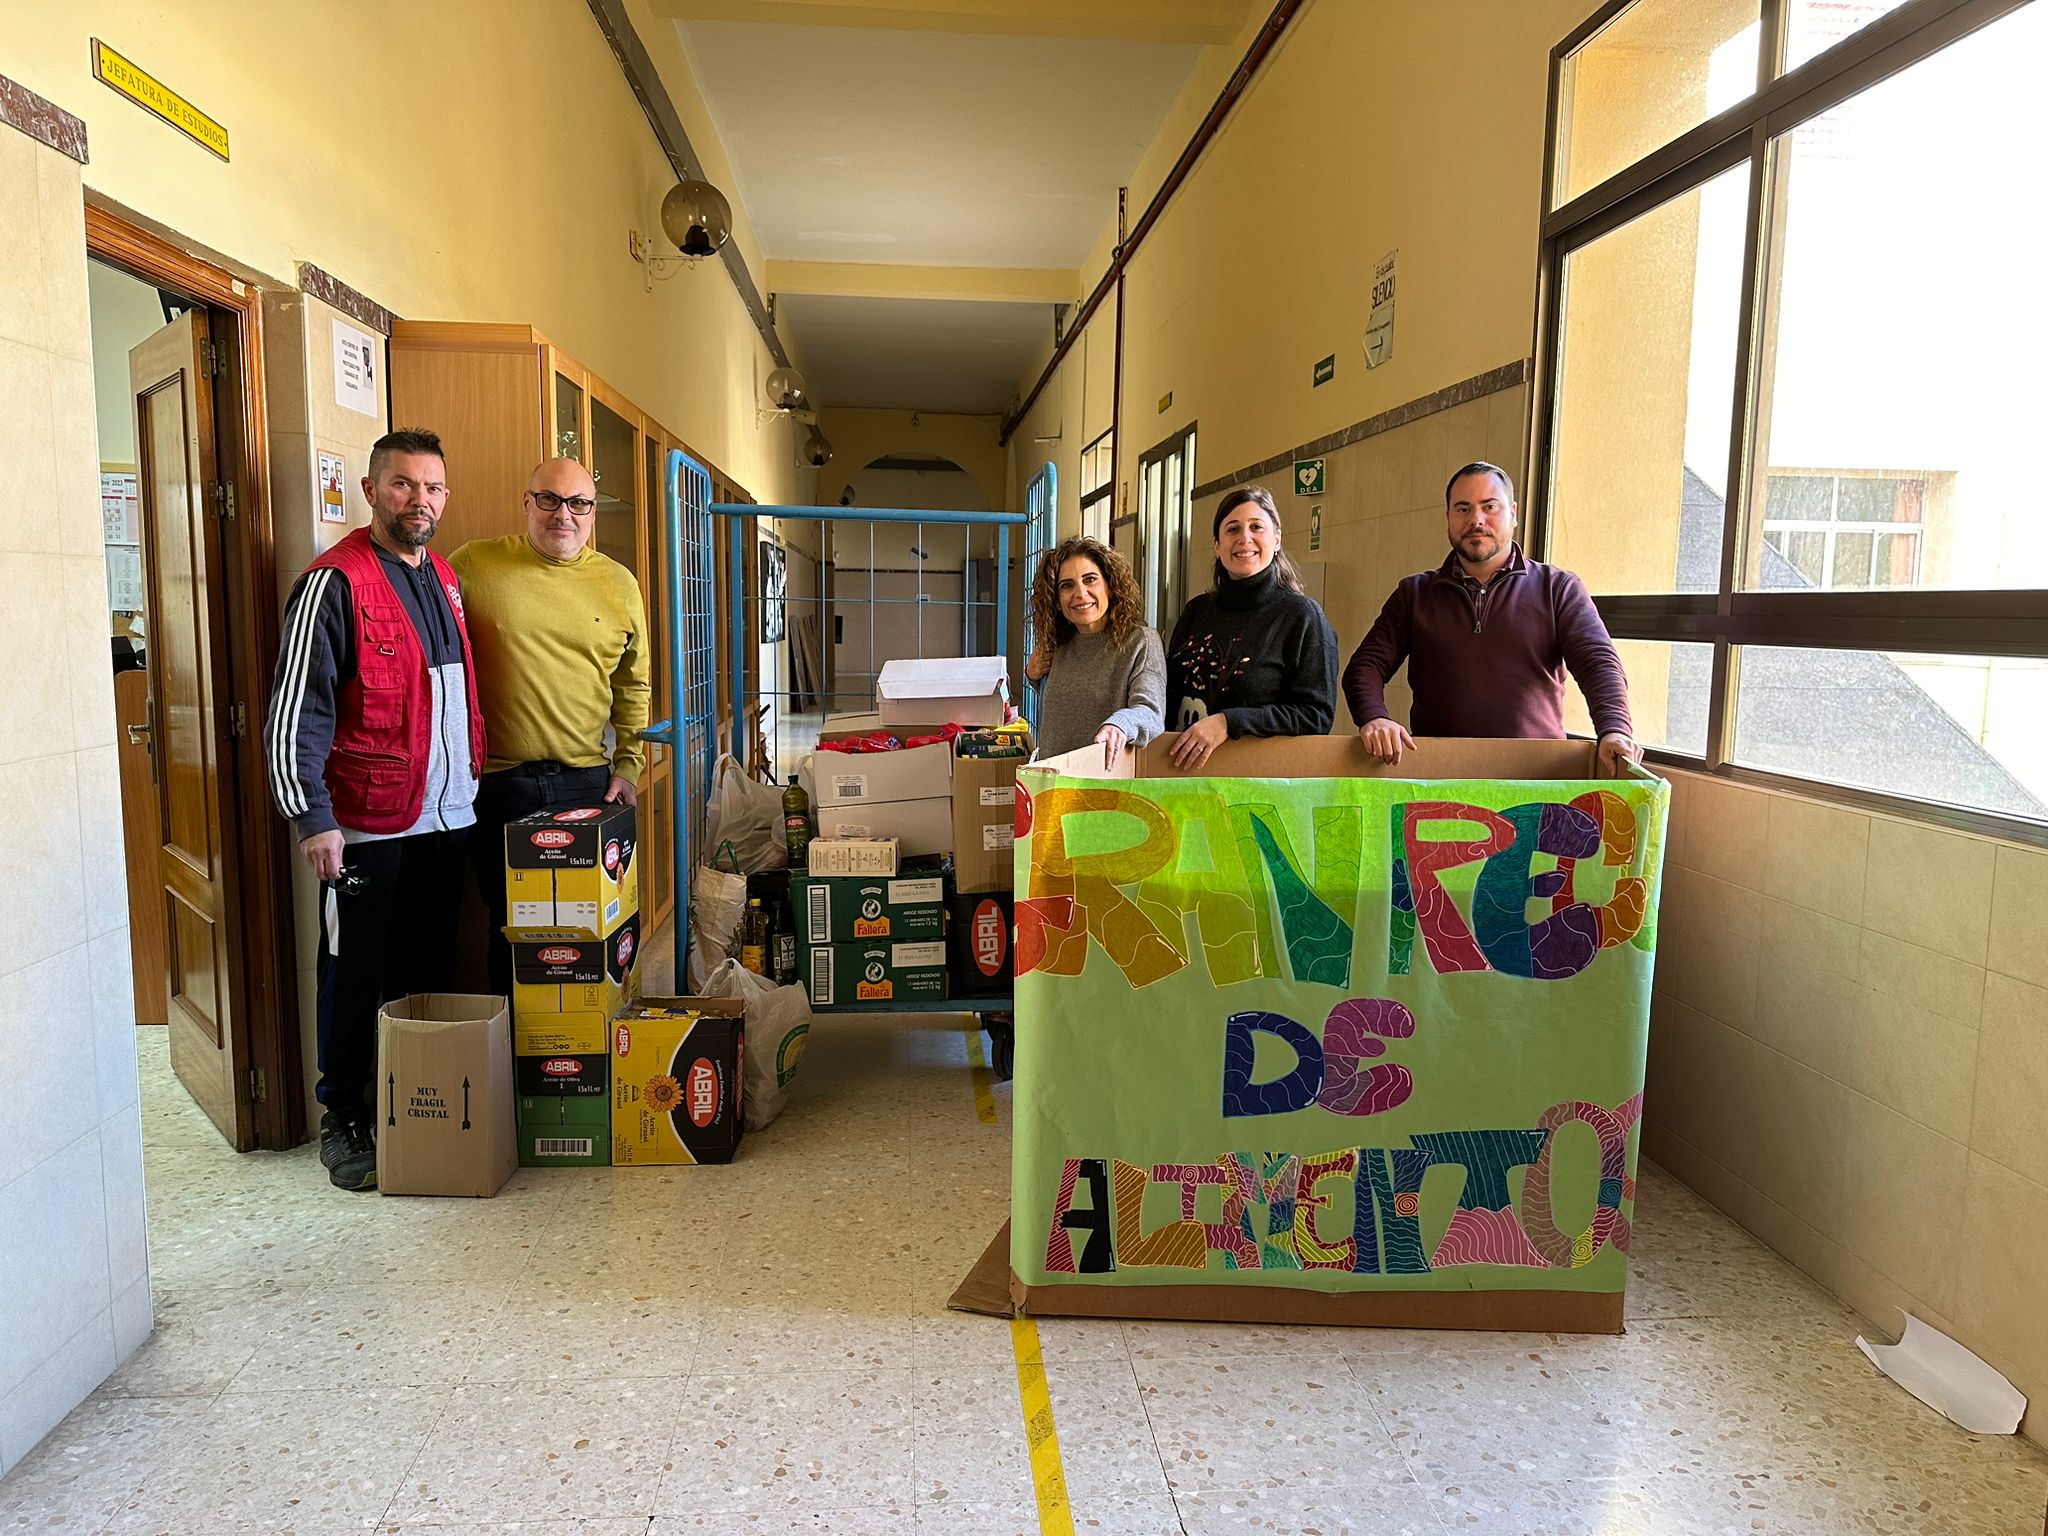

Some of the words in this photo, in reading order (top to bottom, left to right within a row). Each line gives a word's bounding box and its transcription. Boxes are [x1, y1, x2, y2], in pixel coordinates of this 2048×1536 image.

[107, 59, 163, 107] JEFATURA
[167, 97, 180, 118] DE
[182, 109, 224, 147] ESTUDIOS
[112, 479, 124, 487] 2023
[1300, 486, 1318, 494] DEA
[535, 832, 570, 844] ABRIL
[857, 923, 887, 936] Fallera
[979, 906, 999, 967] ABRIL
[543, 949, 577, 960] ABRIL
[859, 986, 890, 998] Fallera
[619, 1028, 628, 1055] ABRIL
[1221, 998, 1416, 1118] DE
[545, 1061, 579, 1072] ABRIL
[616, 1077, 623, 1085] de
[416, 1086, 438, 1096] MUY
[693, 1066, 713, 1121] ABRIL
[410, 1097, 446, 1107] FRAGIL
[407, 1108, 449, 1119] CRISTAL
[642, 1110, 649, 1118] de
